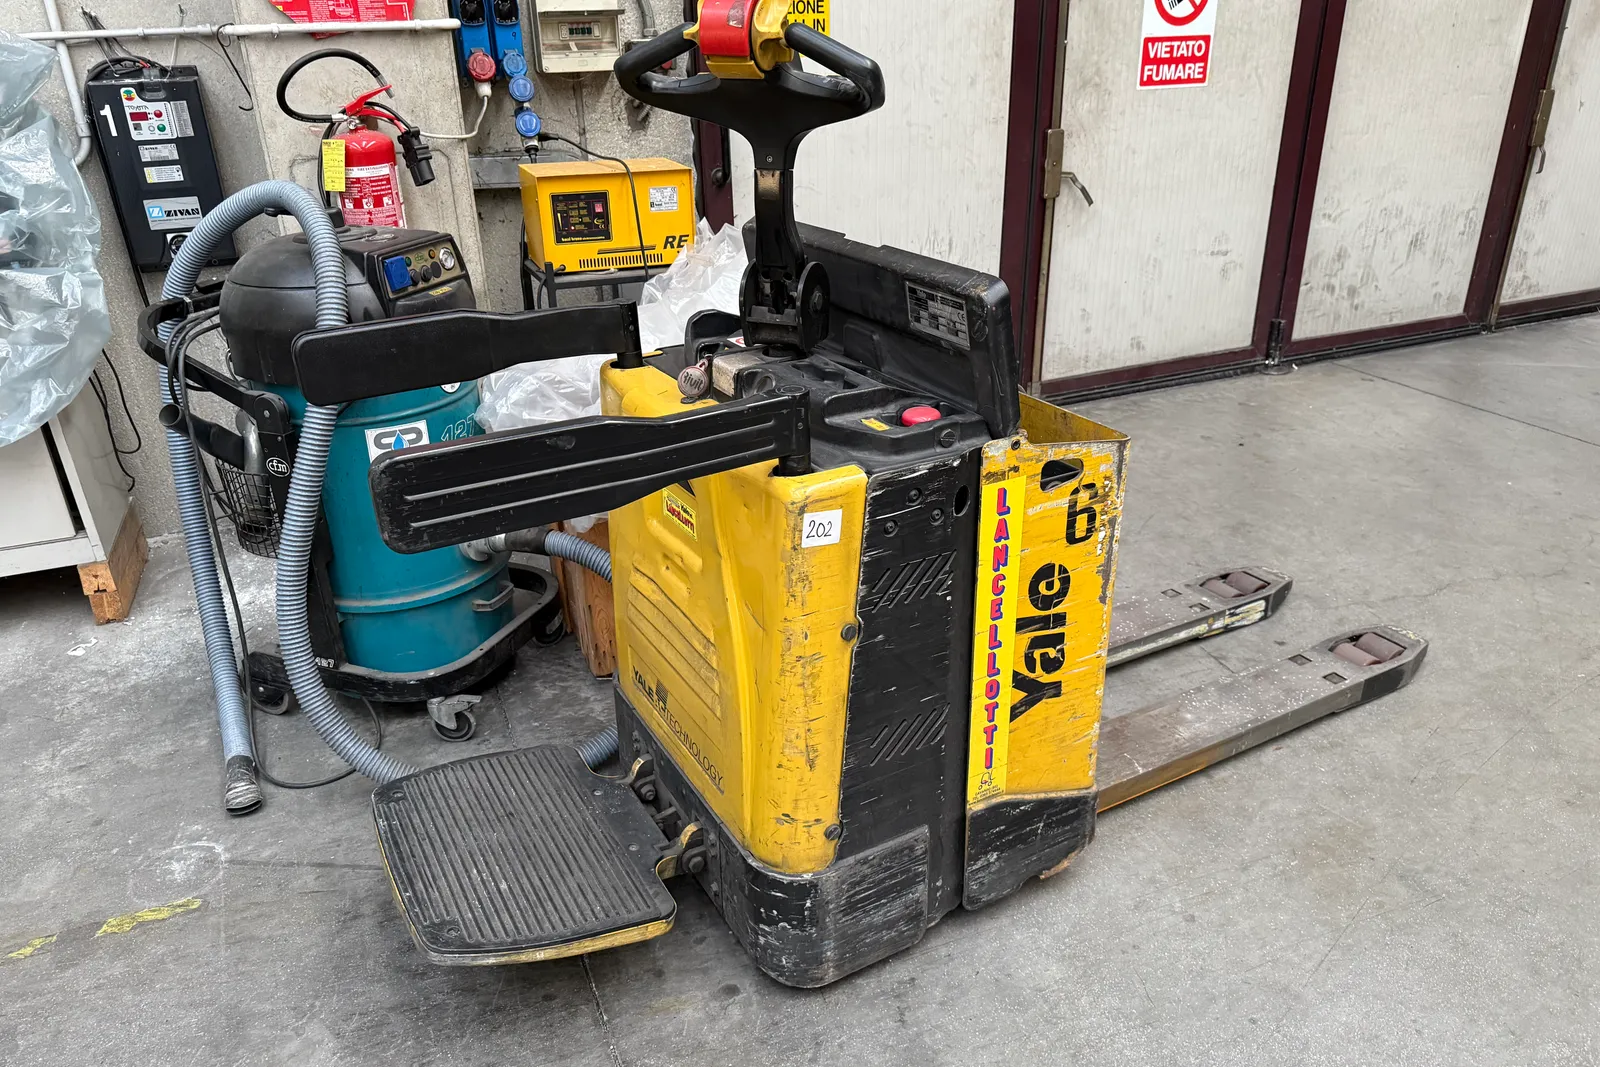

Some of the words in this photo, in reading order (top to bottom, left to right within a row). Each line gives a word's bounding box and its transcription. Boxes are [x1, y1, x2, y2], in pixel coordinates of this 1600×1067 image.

[1148, 40, 1206, 58] VIETATO
[1143, 63, 1205, 82] FUMARE
[99, 104, 118, 137] 1
[164, 208, 200, 217] ZIVAN
[806, 520, 833, 539] 202
[984, 487, 1010, 770] LANCELLOTTI
[1010, 562, 1071, 723] Yale
[633, 665, 655, 702] YALE
[665, 709, 723, 786] TECHNOLOGY
